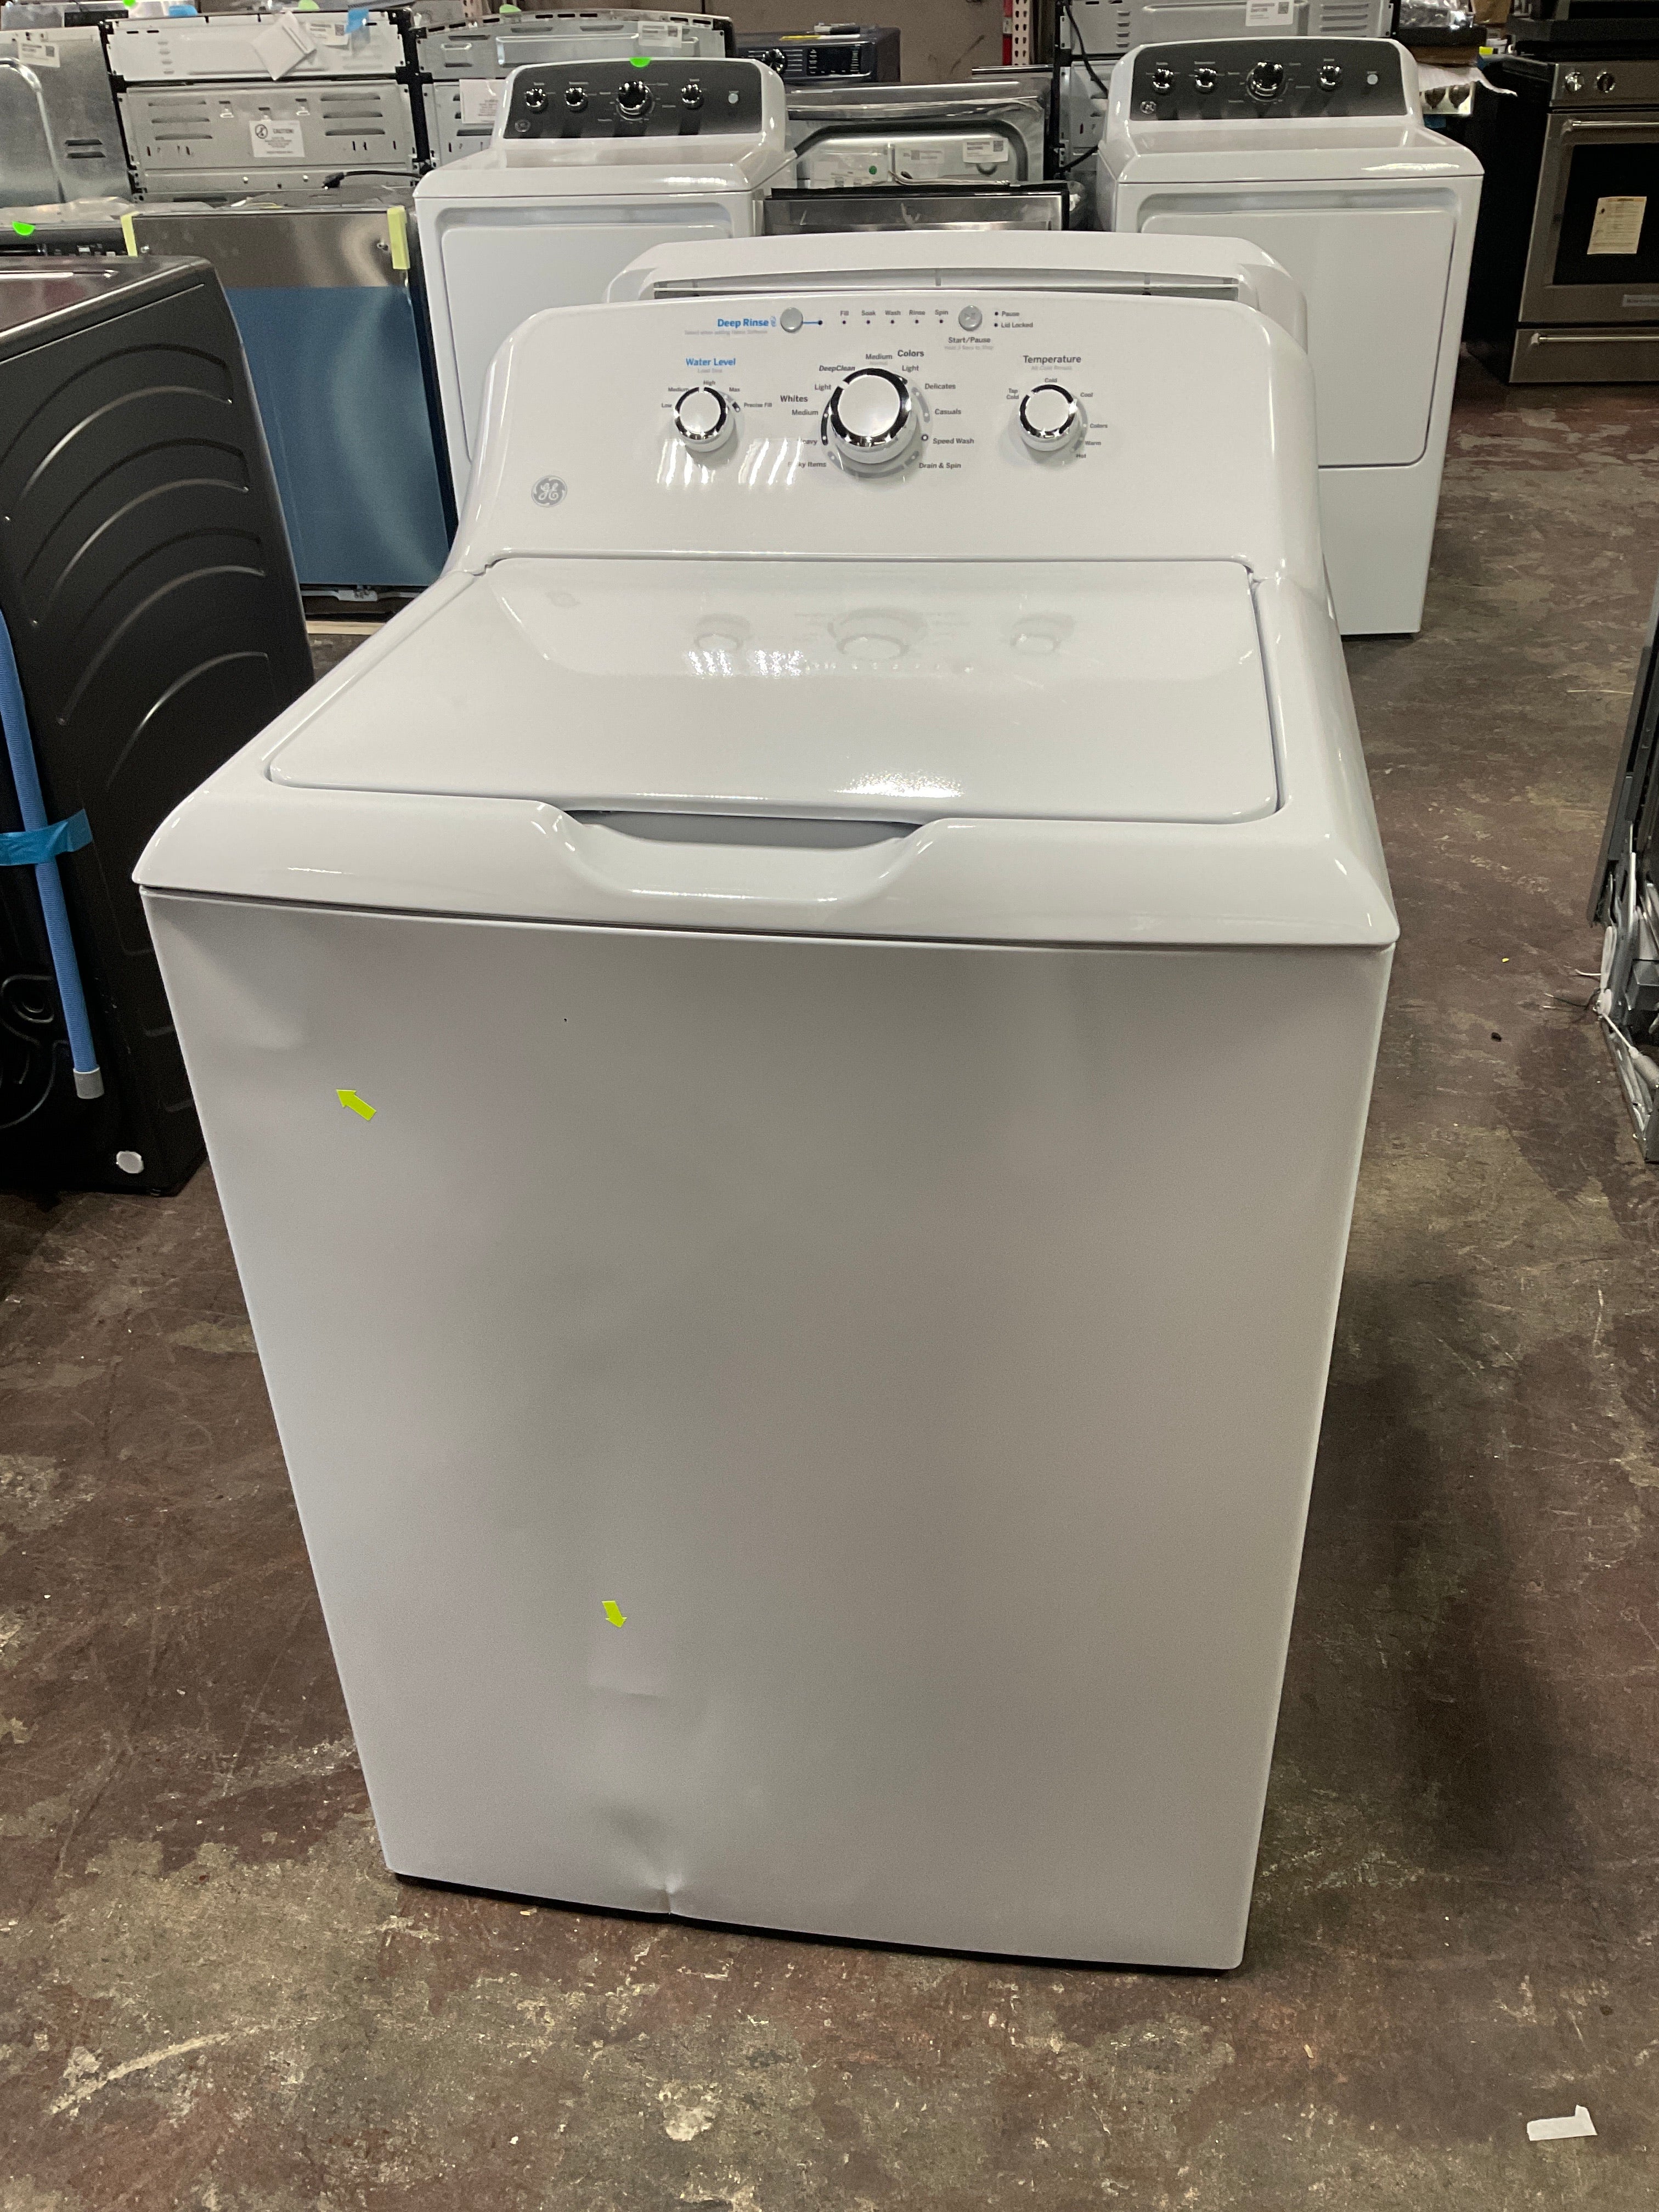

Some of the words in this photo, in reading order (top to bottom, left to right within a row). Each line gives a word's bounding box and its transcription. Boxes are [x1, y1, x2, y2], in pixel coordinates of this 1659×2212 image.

[718, 319, 741, 328] Deep
[743, 318, 769, 326] Rinse
[686, 358, 711, 366] Water
[714, 358, 736, 366] Level
[1023, 355, 1081, 364] Temperature
